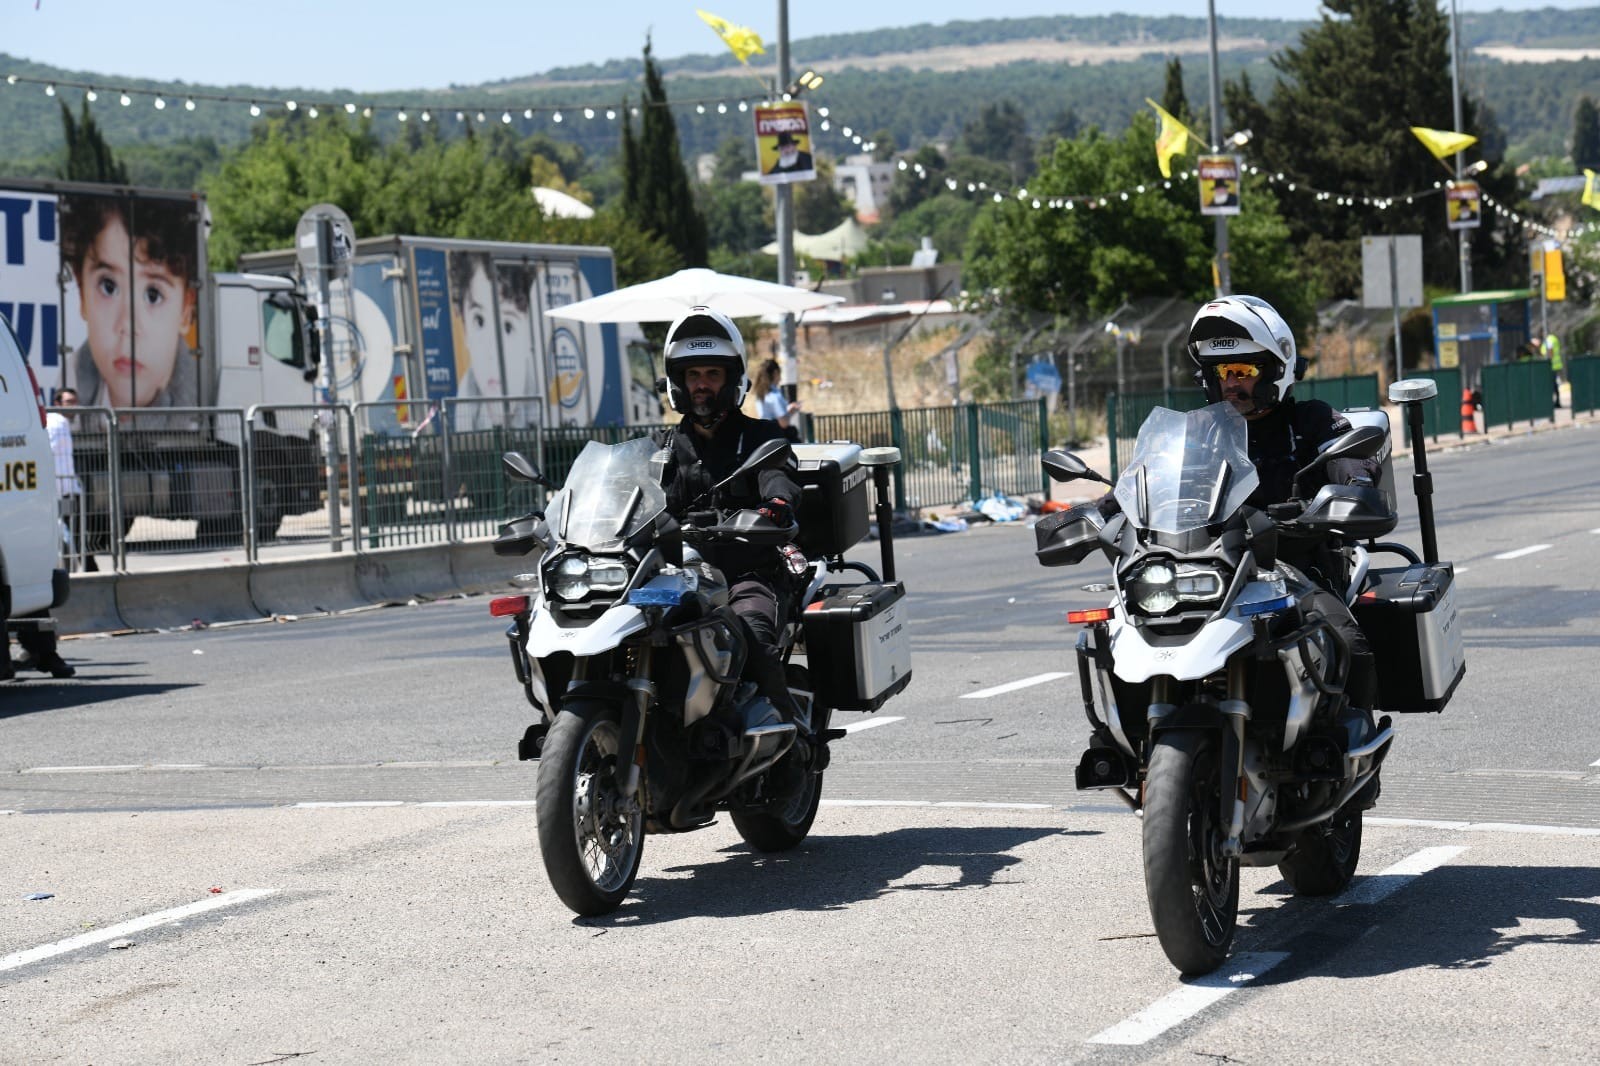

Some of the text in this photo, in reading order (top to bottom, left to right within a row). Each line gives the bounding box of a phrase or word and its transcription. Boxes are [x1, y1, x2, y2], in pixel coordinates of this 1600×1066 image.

[690, 341, 713, 349] SHOEI
[1212, 340, 1235, 348] SHOEI
[0, 461, 37, 492] ICE
